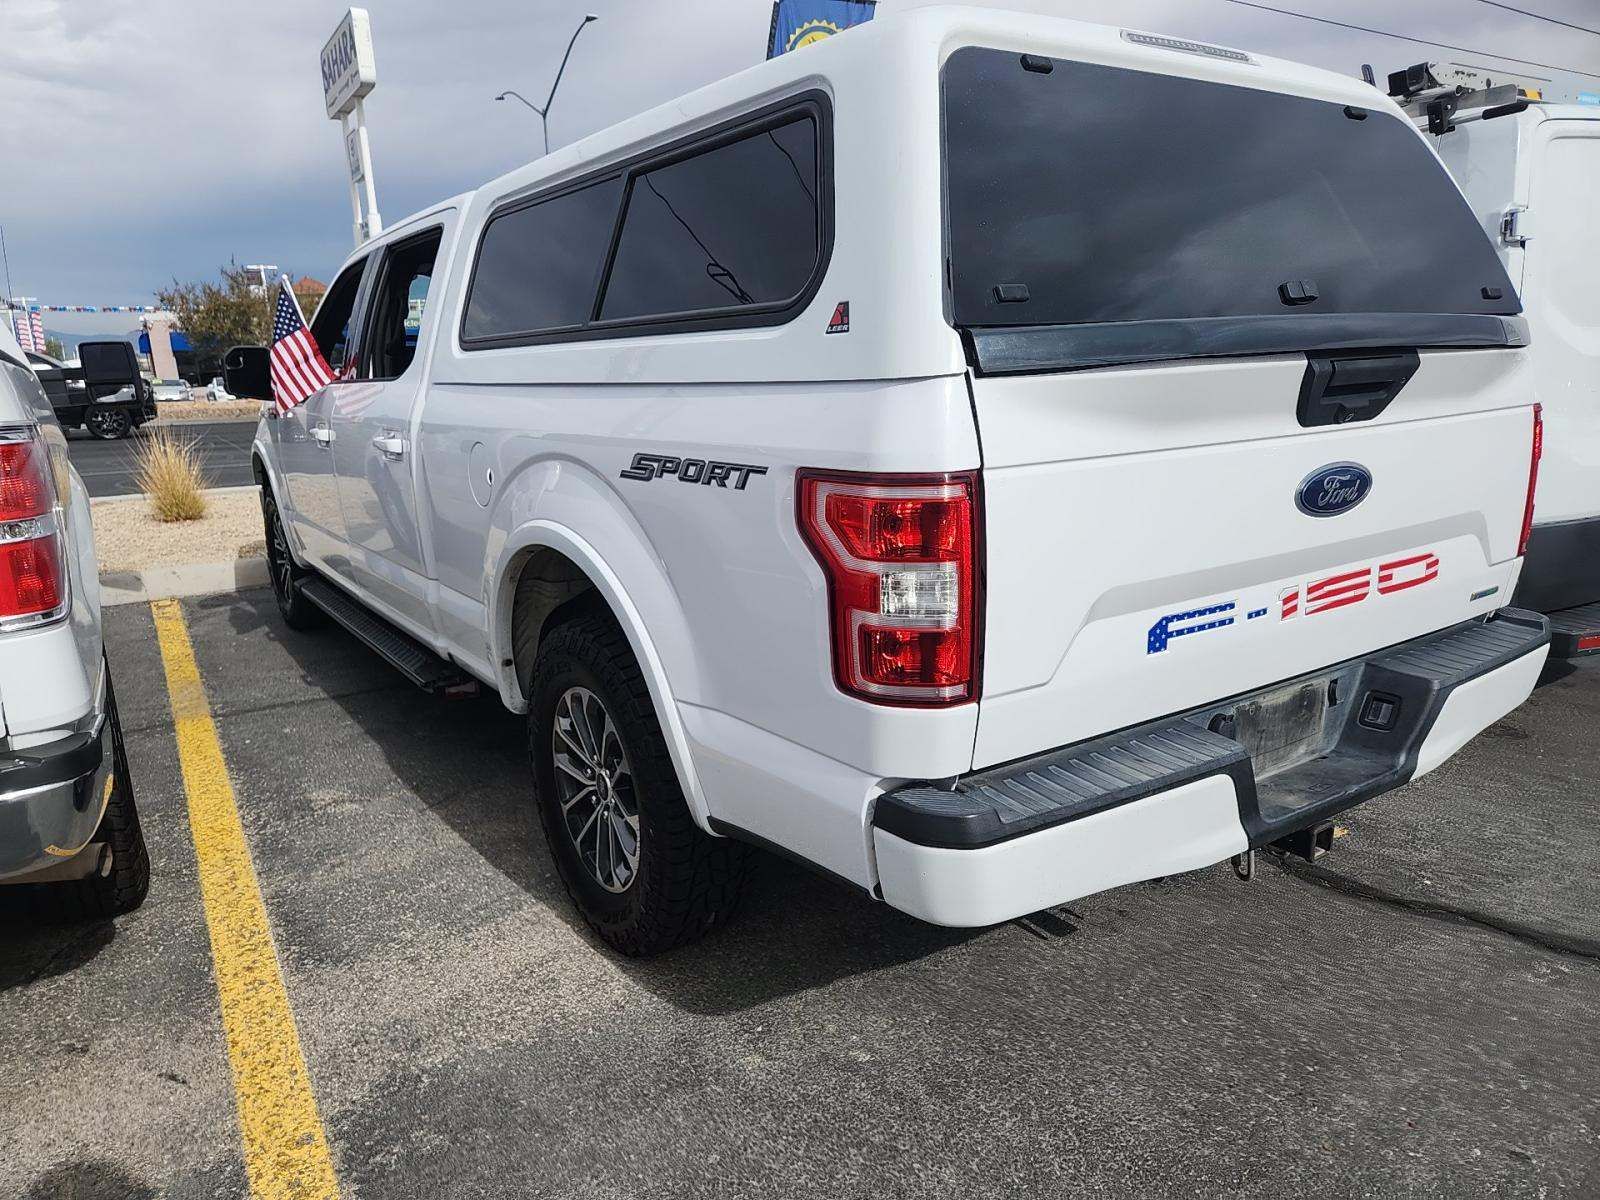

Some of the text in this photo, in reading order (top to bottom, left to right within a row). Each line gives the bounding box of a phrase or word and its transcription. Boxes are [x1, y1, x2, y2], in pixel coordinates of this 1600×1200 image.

[827, 324, 849, 332] LEER
[619, 452, 769, 490] SPORT
[1318, 474, 1360, 507] Ford
[1147, 552, 1439, 655] F-150
